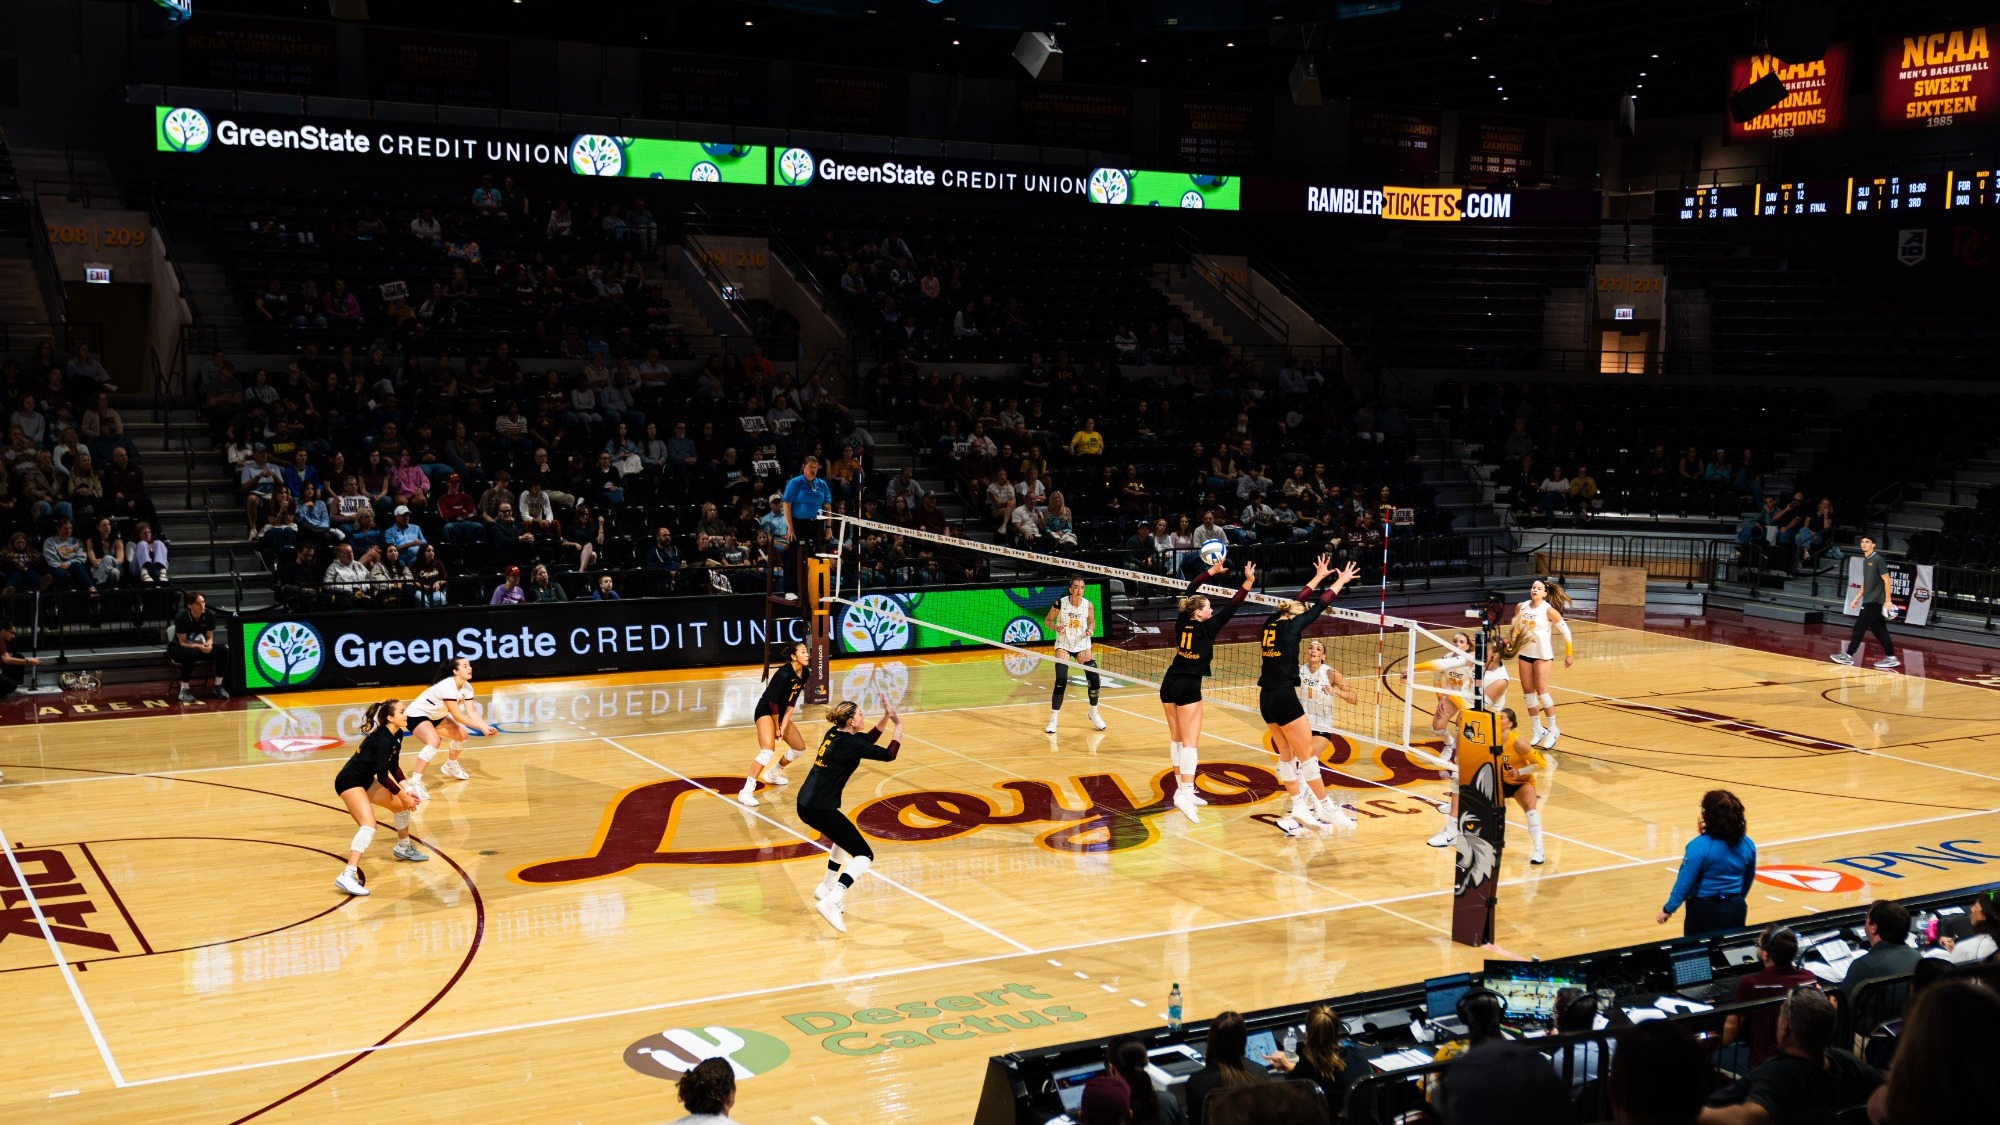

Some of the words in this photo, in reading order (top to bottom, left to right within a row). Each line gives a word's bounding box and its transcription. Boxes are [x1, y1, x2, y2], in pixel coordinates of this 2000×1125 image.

[233, 40, 332, 57] TOURNAMENT
[1900, 28, 1989, 69] NCAA
[1899, 69, 1928, 80] MEN'S
[1930, 61, 1989, 77] BASKETBALL
[1914, 75, 1972, 97] SWEET
[1053, 102, 1129, 117] TOURNAMENT
[1906, 95, 1978, 119] SIXTEEN
[1743, 108, 1826, 131] CHAMPIONS
[1926, 115, 1953, 128] 1985
[1771, 128, 1795, 139] 1963
[217, 121, 370, 153] GreenState
[379, 135, 477, 161] CREDIT
[487, 141, 568, 165] UNION
[819, 158, 936, 186] GreenState
[942, 170, 1017, 191] CREDIT
[1024, 174, 1088, 195] UNION
[1858, 186, 1870, 197] SLU
[1879, 186, 1883, 196] 1
[1892, 184, 1899, 194] 11
[1909, 182, 1927, 194] 19:06
[1958, 180, 1971, 191] FOR
[1979, 179, 1985, 189] 0
[1698, 197, 1704, 206] 0
[1710, 195, 1718, 205] 12
[1765, 192, 1778, 202] DAV
[1784, 191, 1789, 201] 0
[1797, 190, 1805, 200] 12
[1857, 200, 1868, 211] GW
[1878, 200, 1882, 210] 1
[1890, 199, 1899, 209] 18
[1908, 197, 1922, 208] 3RD
[1956, 195, 1970, 206] DUQ
[1980, 194, 1984, 205] 1
[1681, 210, 1693, 220] GMU
[1698, 209, 1703, 219] 3
[1709, 208, 1718, 218] 25
[1722, 208, 1738, 218] FINAL
[1765, 205, 1777, 216] DAY
[1783, 205, 1789, 214] 3
[1795, 204, 1804, 214] 25
[1810, 203, 1827, 213] FINAL
[47, 224, 89, 246] 208
[104, 226, 146, 248] 209
[736, 251, 767, 269] 210
[90, 270, 108, 281] EXIT
[1598, 278, 1625, 294] 211
[1634, 278, 1660, 294] 211
[343, 498, 357, 507] LET'S
[358, 498, 366, 507] GO
[1899, 572, 1910, 580] THE
[1902, 586, 1910, 596] 10
[334, 626, 557, 669] GreenState
[570, 621, 709, 655] CREDIT
[1180, 631, 1193, 650] 11
[1262, 629, 1276, 647] 12
[782, 982, 1054, 1036] Desert
[821, 1004, 1088, 1057] Cactus
